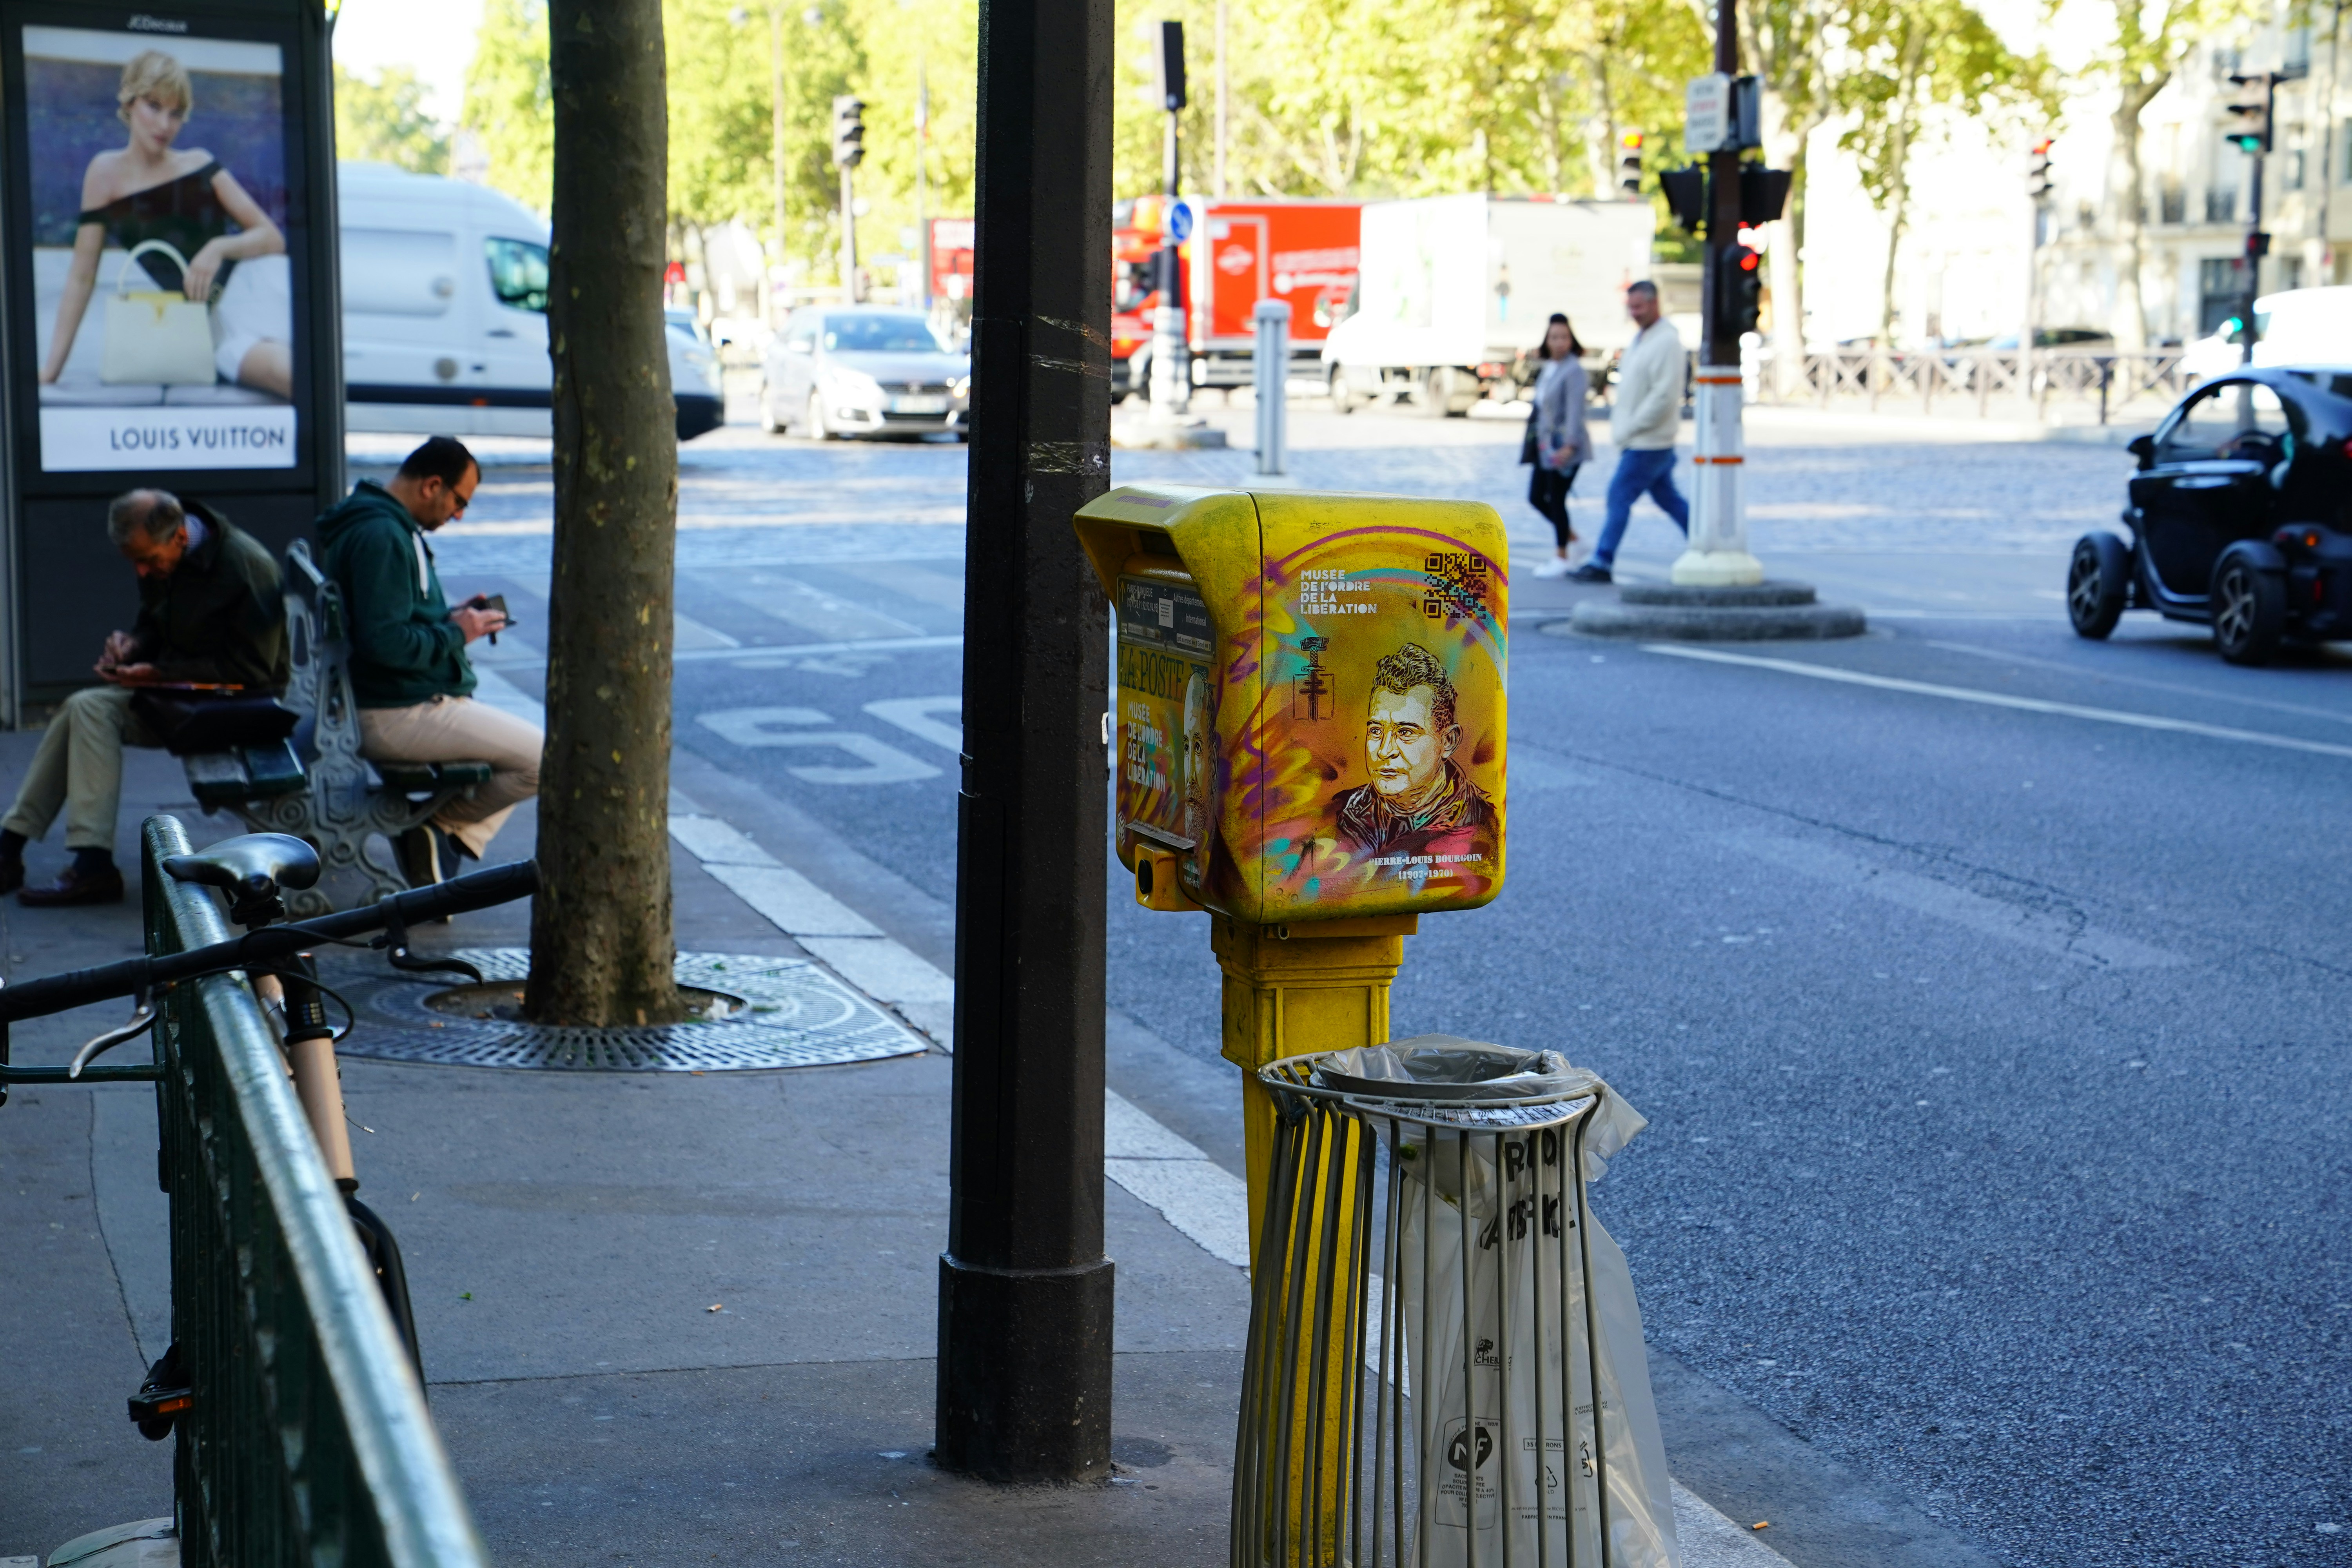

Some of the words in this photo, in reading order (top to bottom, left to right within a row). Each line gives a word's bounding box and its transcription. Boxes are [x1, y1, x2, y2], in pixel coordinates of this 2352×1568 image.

[110, 428, 180, 450] LOUIS
[186, 427, 285, 449] VUITTON
[1301, 569, 1345, 580] MUSÉE
[1301, 582, 1318, 592] DE
[1173, 593, 1184, 603] Autres
[1301, 593, 1318, 603] DE
[1321, 593, 1337, 603] LA
[1301, 603, 1377, 614] LIBÉRATION
[1186, 613, 1206, 626] International
[1118, 646, 1136, 690] LA
[1139, 650, 1184, 702] POSTE
[1128, 701, 1150, 723] MUSÉE
[1128, 721, 1136, 740] DE
[1128, 741, 1136, 761] DE
[1137, 746, 1145, 764] LA
[1368, 856, 1433, 866] PIERRE-LOUIS
[1435, 853, 1482, 863] BOURGOIN
[1398, 868, 1453, 880] (1907-1970)
